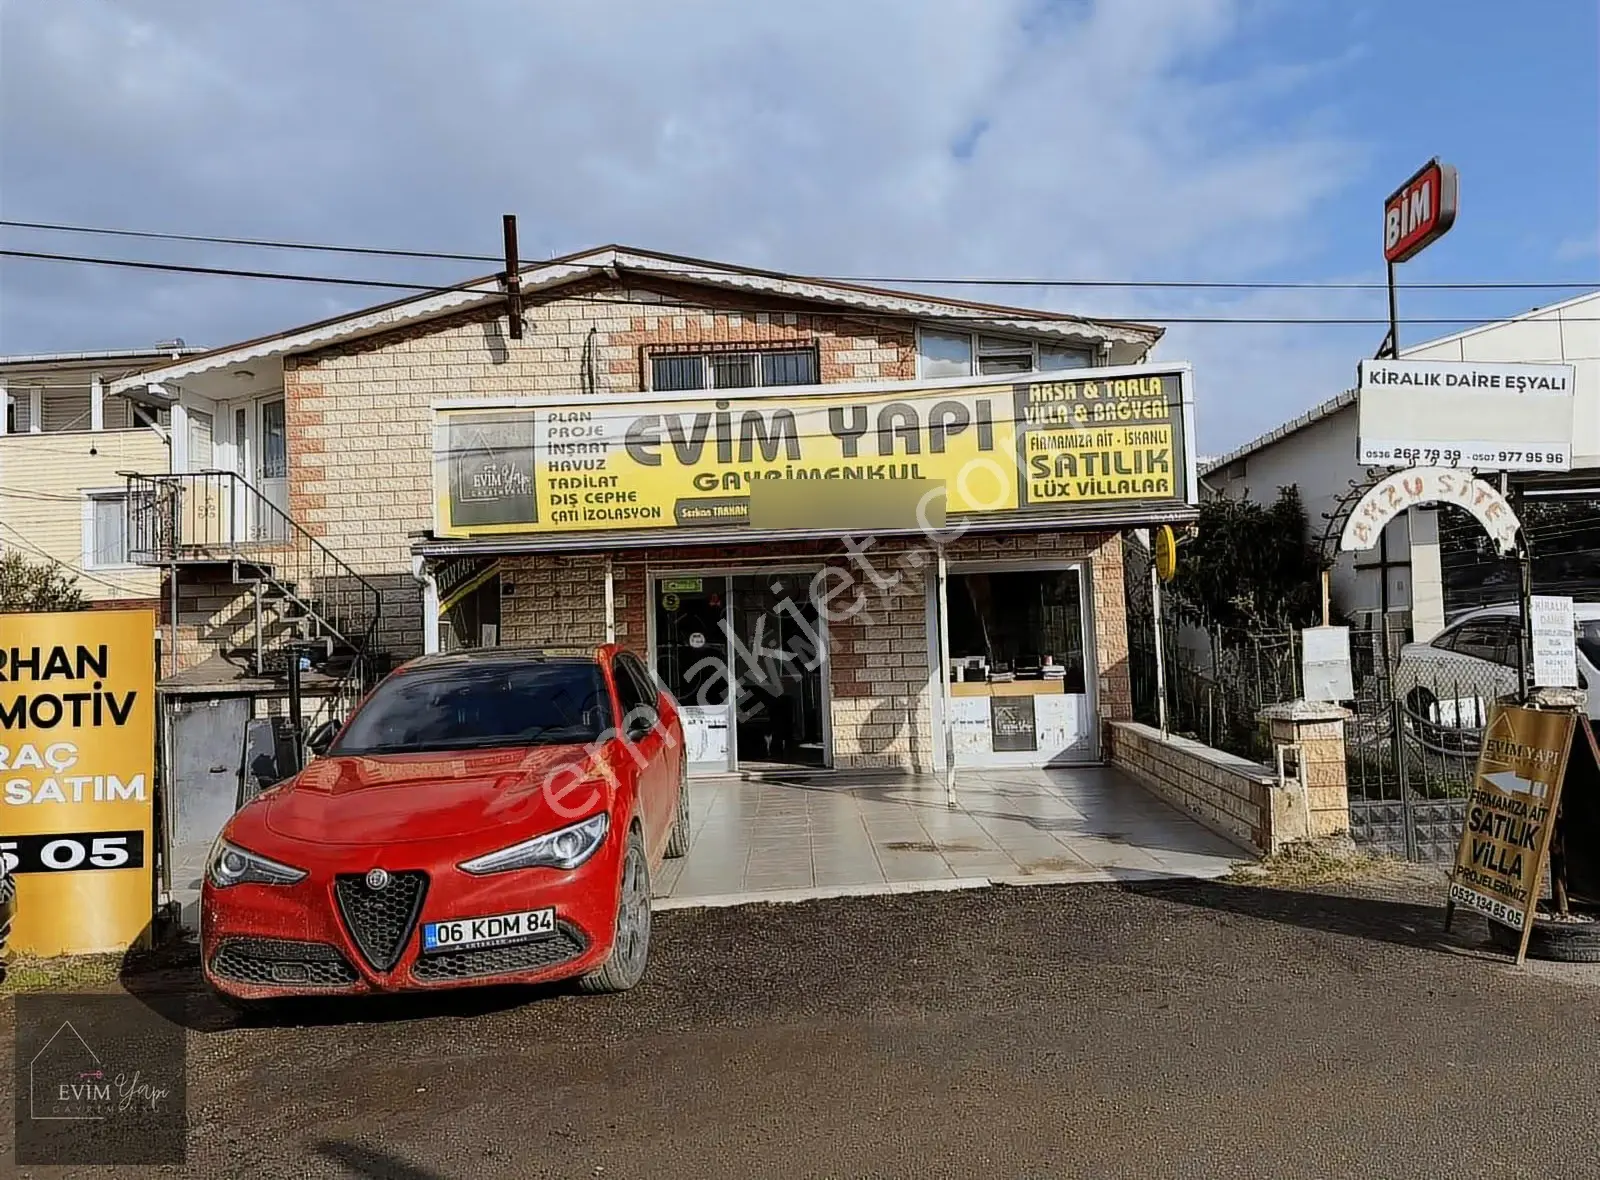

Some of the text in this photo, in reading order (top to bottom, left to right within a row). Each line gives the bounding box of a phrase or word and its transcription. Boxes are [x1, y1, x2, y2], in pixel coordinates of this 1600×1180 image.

[1387, 181, 1430, 250] BİM
[1029, 376, 1162, 402] ARSA & TARLA
[1370, 368, 1566, 393] KİRALIK DAİRE EŞYALI
[548, 412, 592, 423] PLAN
[1024, 401, 1069, 425] VİLLA
[1074, 403, 1088, 422] &
[548, 426, 603, 438] PROJE
[624, 400, 994, 466] EVİM YAPI
[1031, 433, 1093, 450] FİRMAMIZA
[1097, 430, 1113, 447] AİT
[1124, 428, 1167, 446] İSKANLI
[548, 441, 609, 457] İNŞAAT
[1394, 448, 1420, 460] 262
[1498, 451, 1523, 462] 977
[1526, 452, 1542, 462] 95
[1546, 453, 1563, 463] 96
[548, 459, 606, 472] HAVUZ
[1031, 449, 1169, 479] SATILIK
[548, 474, 618, 489] TADİLAT
[1034, 478, 1169, 497] LÜX VİLLALAR
[550, 491, 637, 508] DIŞ CEPHE
[551, 506, 660, 525] ÇATI İZOLASYON
[3, 774, 146, 806] SATIM
[1470, 786, 1549, 822] FİRMAMIZA AİT
[1469, 807, 1541, 851] SATILIK
[1472, 838, 1523, 880] VİLLA
[1457, 866, 1527, 902] PROJELERİMİZ
[438, 911, 551, 943] 06 KDM 84
[1507, 910, 1522, 925] 05
